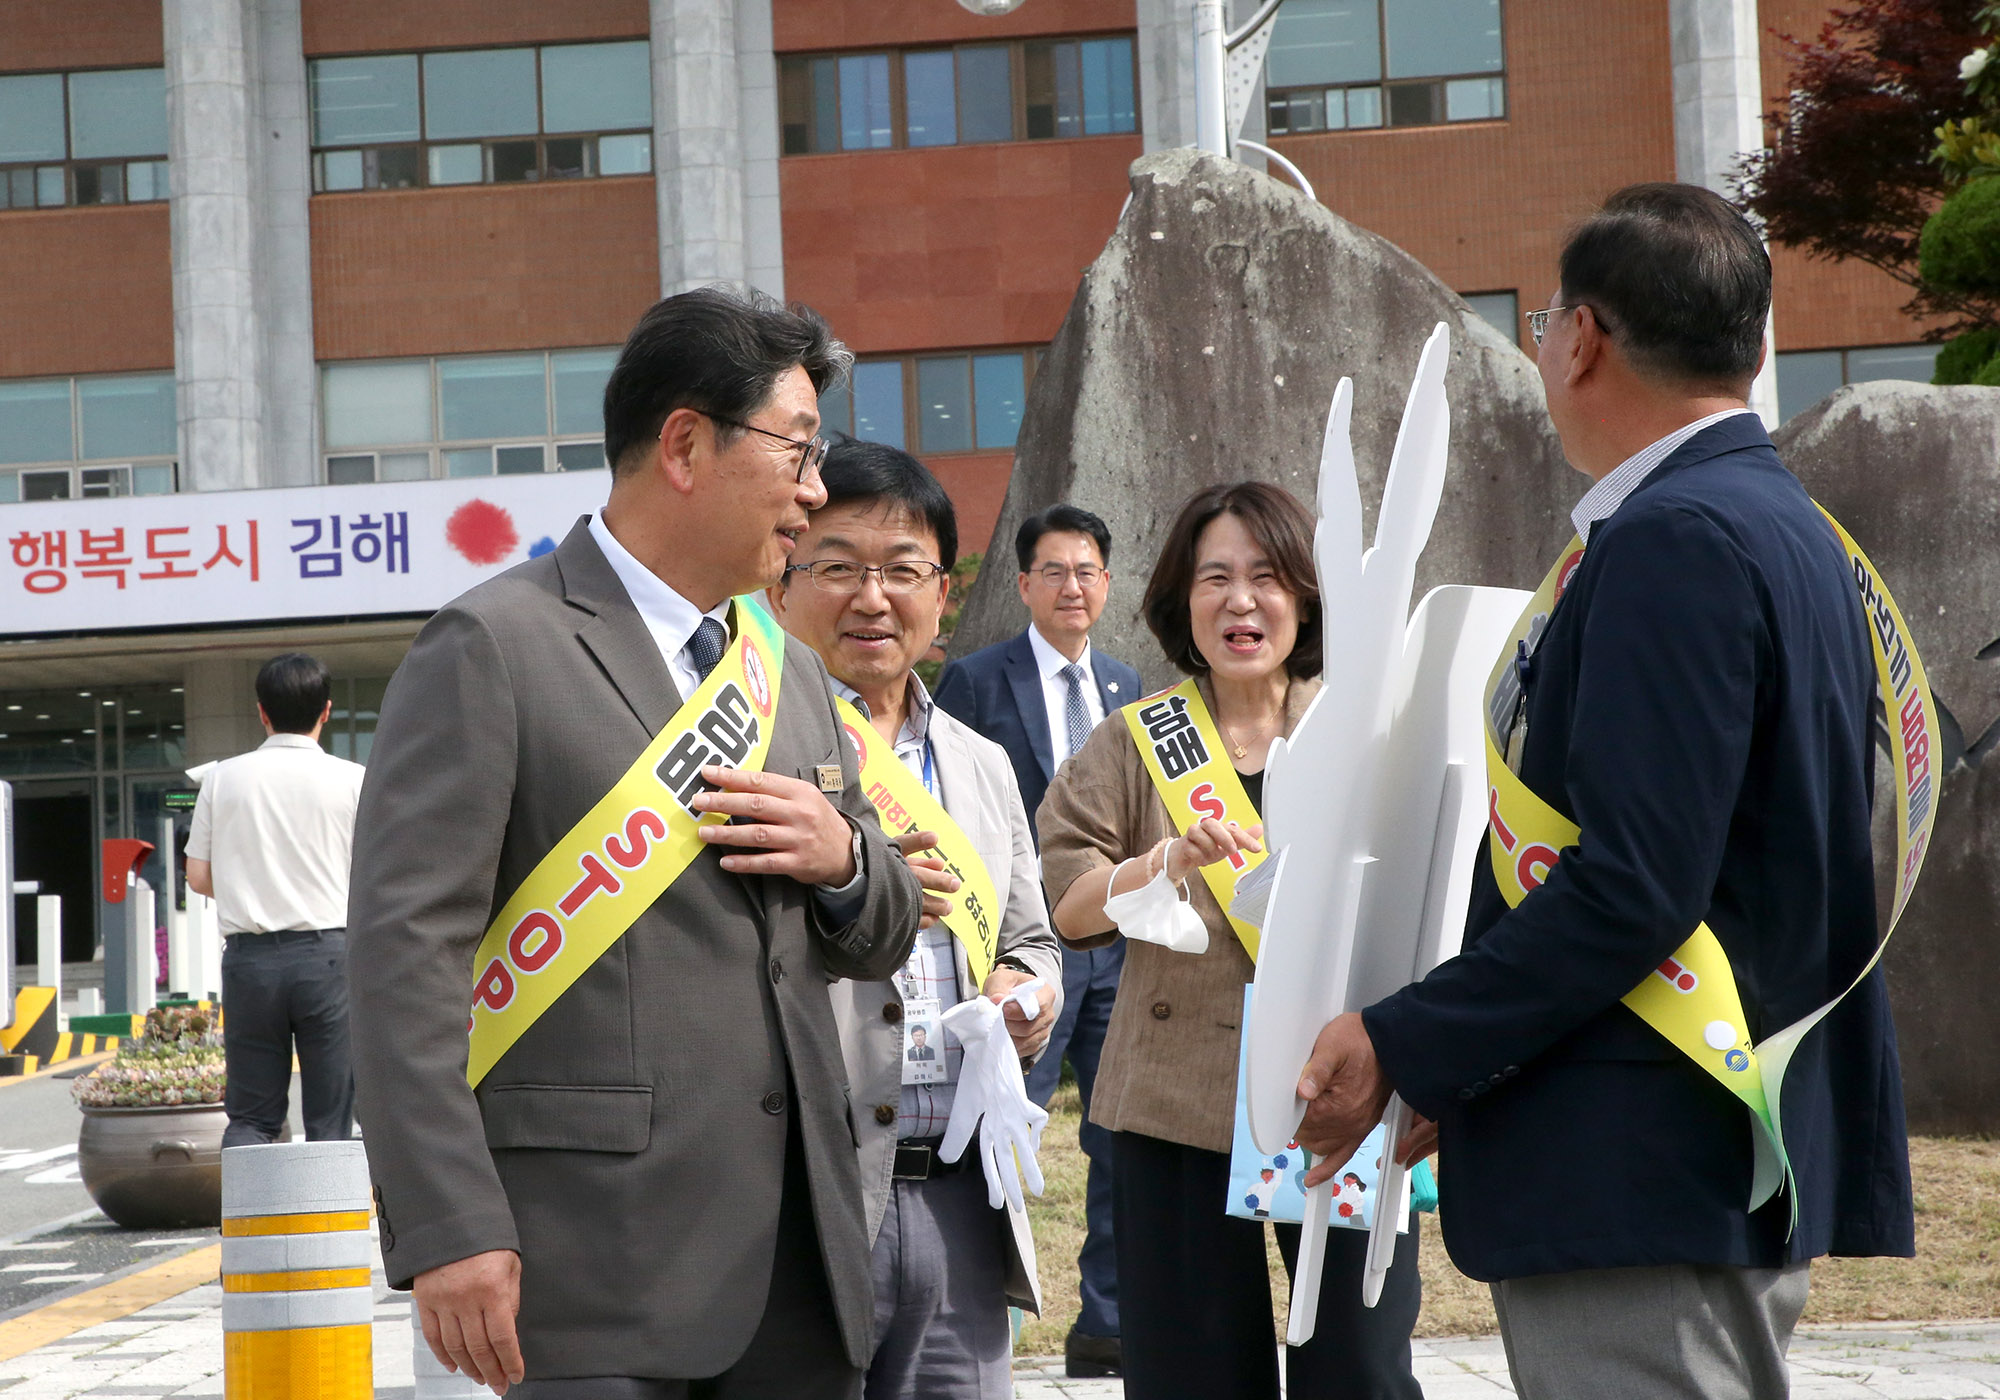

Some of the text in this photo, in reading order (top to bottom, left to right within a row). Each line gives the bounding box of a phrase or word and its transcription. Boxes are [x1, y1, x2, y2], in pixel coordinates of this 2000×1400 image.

[9, 511, 410, 594] 행복도시 김해
[656, 683, 759, 818] 담배
[1139, 696, 1210, 780] 담배
